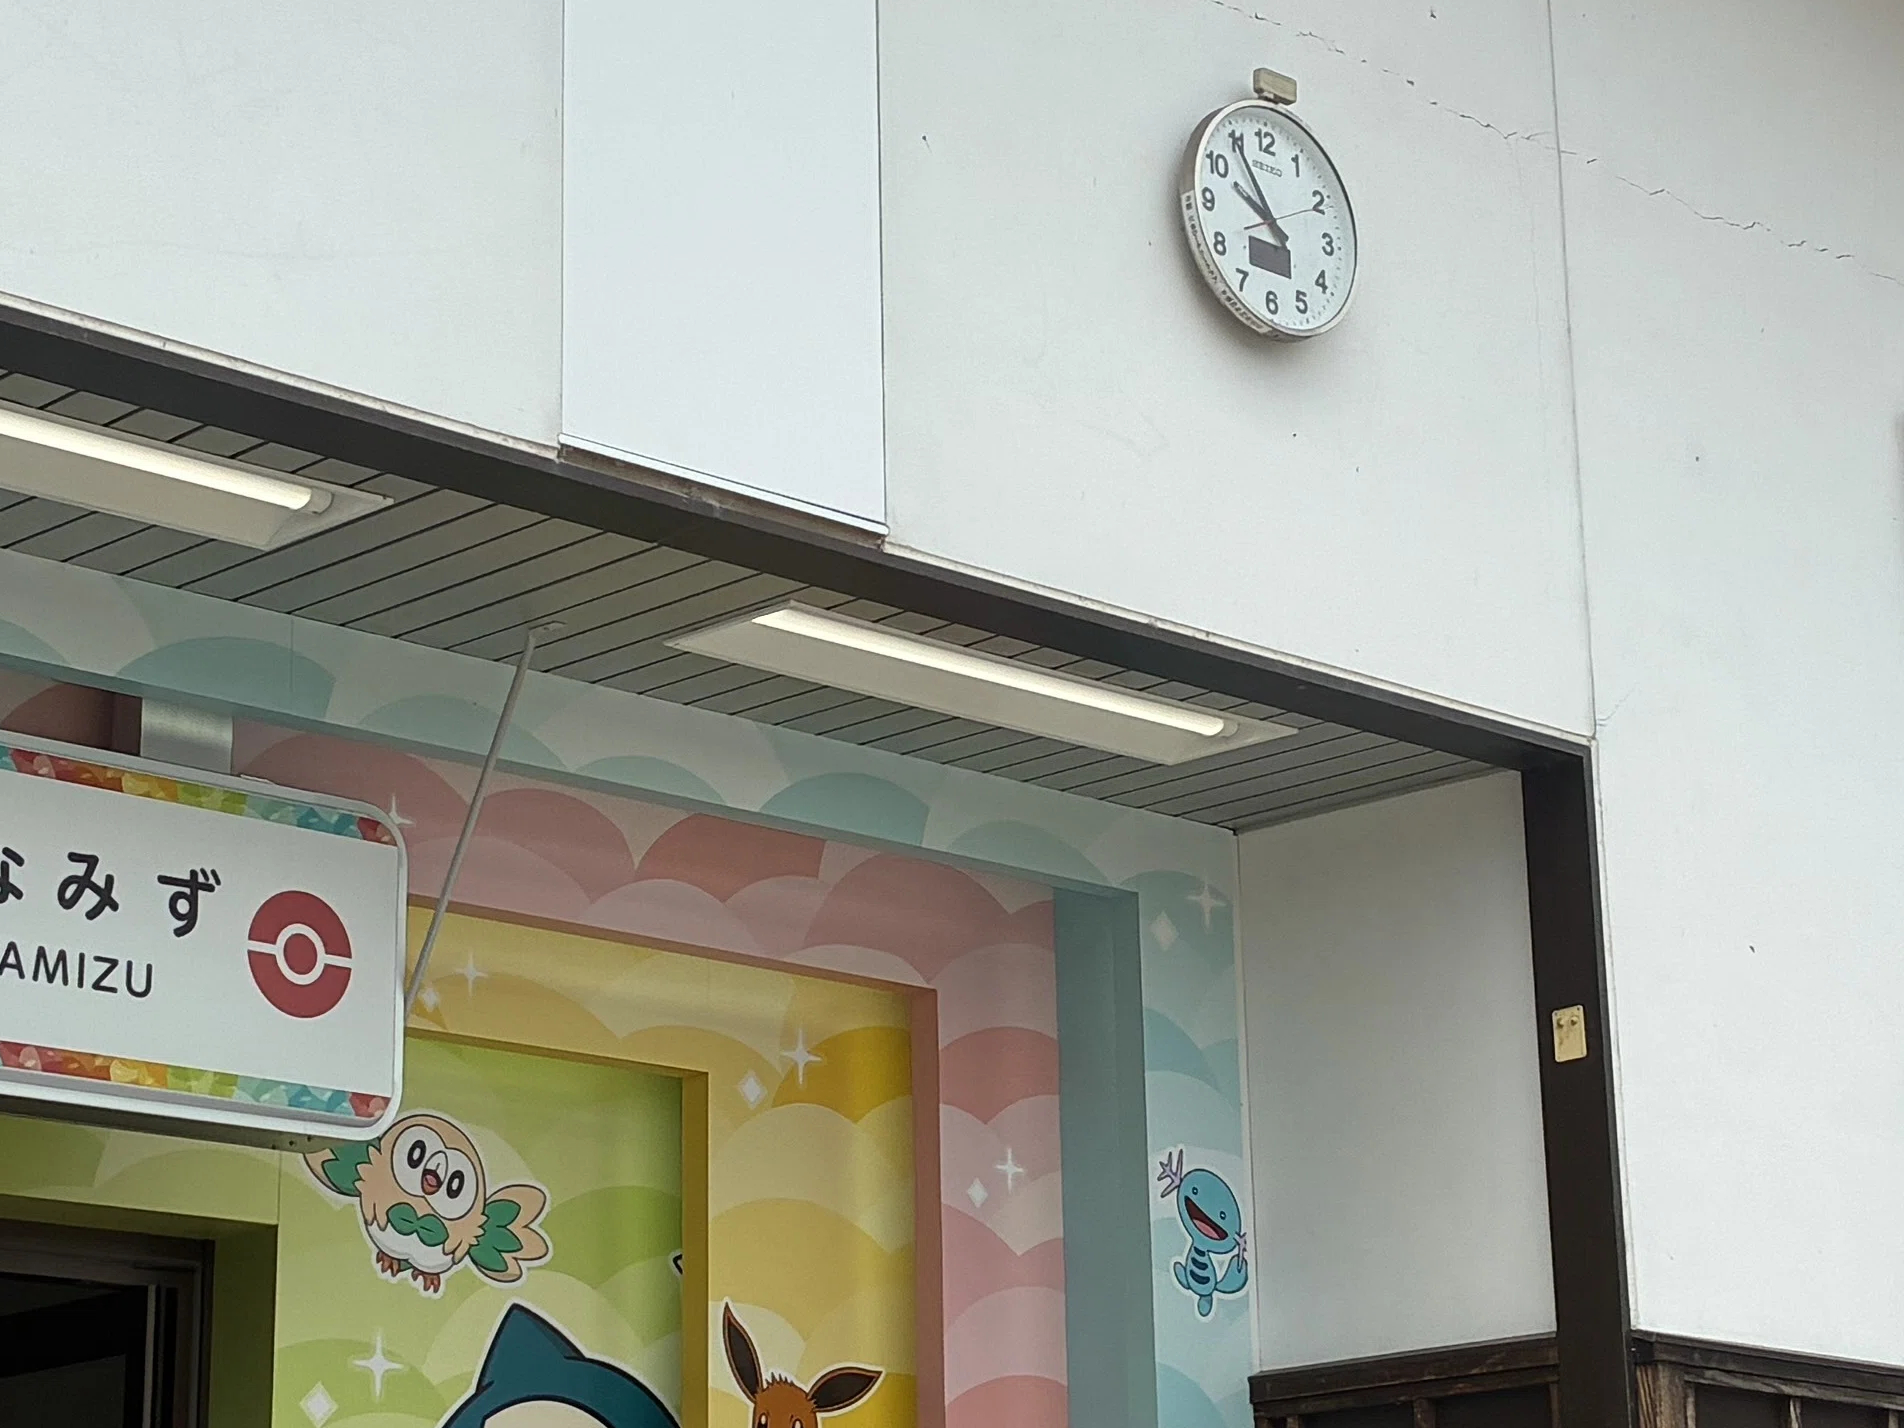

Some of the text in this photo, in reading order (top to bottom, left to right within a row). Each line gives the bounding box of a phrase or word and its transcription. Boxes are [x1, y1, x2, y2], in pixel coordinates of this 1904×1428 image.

[1254, 128, 1276, 156] 12
[1206, 150, 1229, 178] 10
[1201, 187, 1215, 211] 9
[1312, 190, 1326, 215] 2
[1213, 231, 1227, 256] 8
[1321, 232, 1334, 257] 3
[1236, 268, 1249, 292] 7
[1315, 269, 1328, 294] 4
[1265, 290, 1279, 315] 6
[1295, 290, 1309, 314] 5
